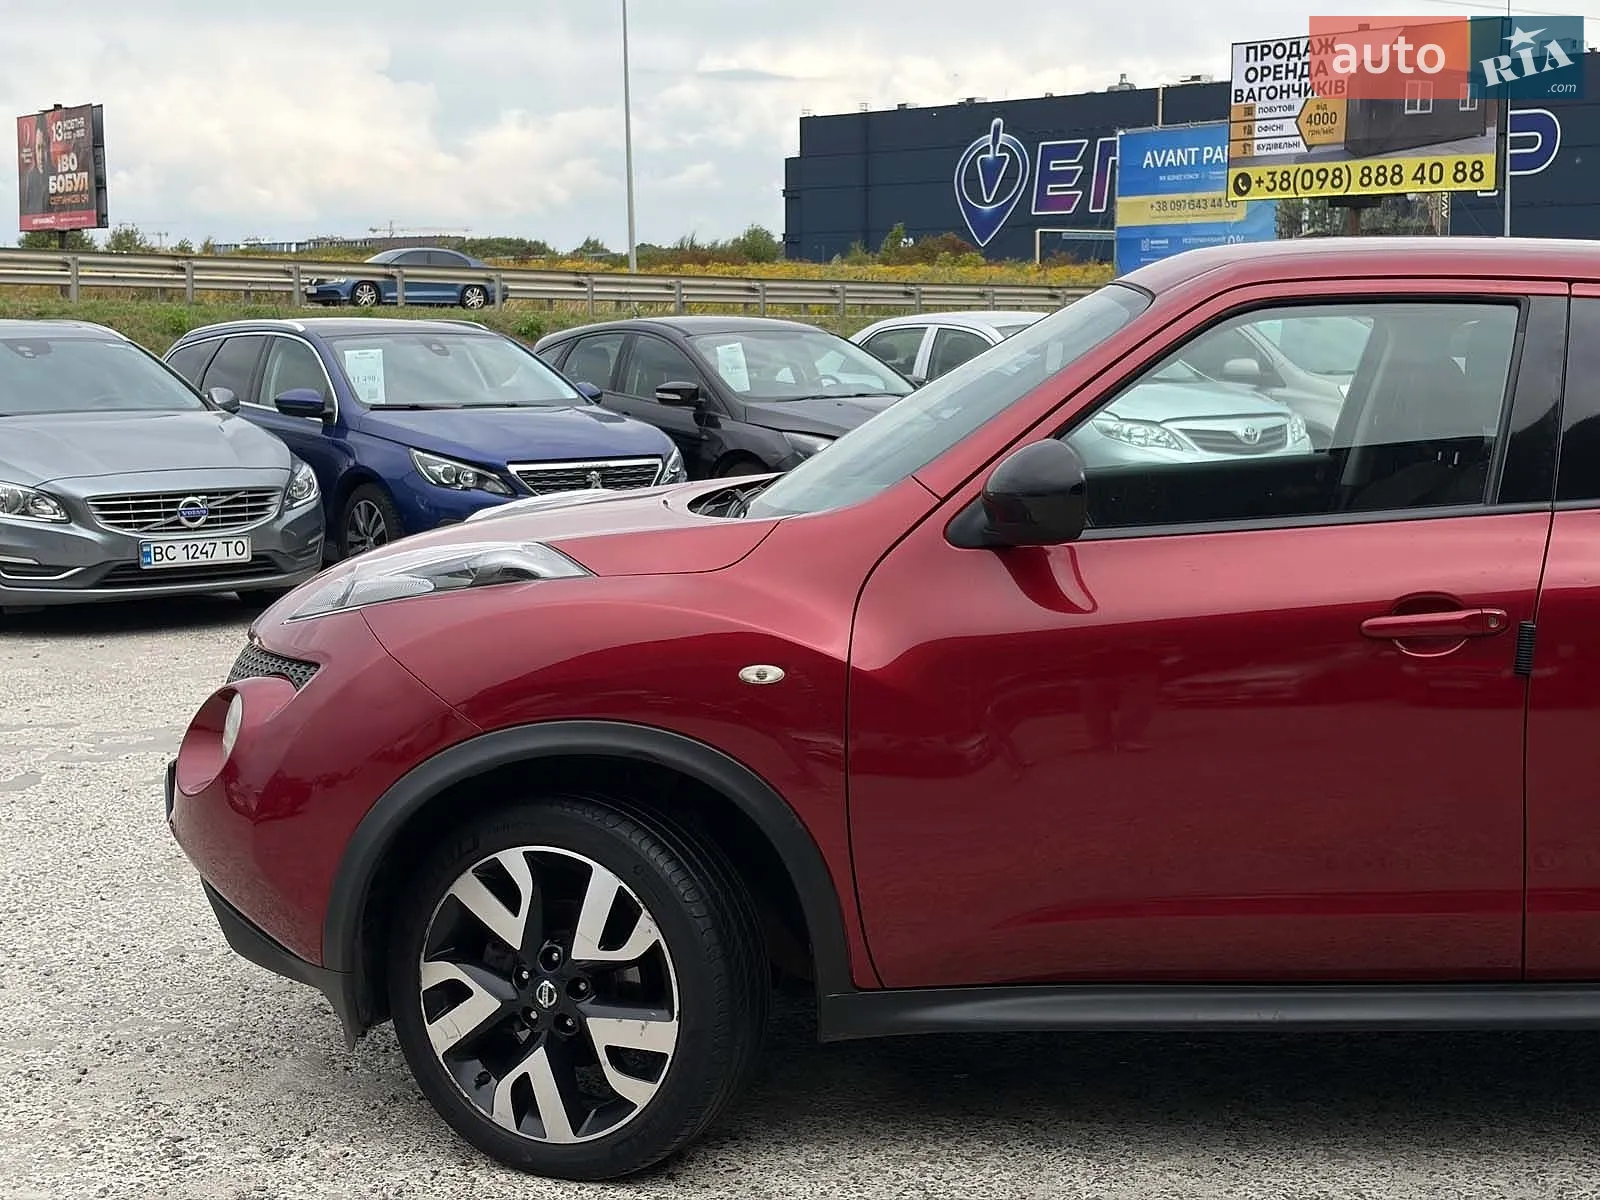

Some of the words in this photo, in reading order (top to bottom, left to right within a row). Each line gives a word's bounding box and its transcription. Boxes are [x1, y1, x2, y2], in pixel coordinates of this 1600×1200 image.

[1246, 37, 1337, 62] ПРОДАЖ
[1245, 59, 1329, 83] ОРЕНДА
[1234, 80, 1346, 104] ВАГОНЧИКІВ
[1258, 104, 1295, 115] ПОБУТОВІ
[1306, 111, 1338, 127] 4000
[51, 121, 63, 142] 13
[1257, 124, 1284, 133] ОФІСНІ
[1256, 142, 1301, 152] БУДІВЕЛЬНІ
[57, 152, 78, 173] ІВО
[1143, 147, 1200, 169] AVANT
[48, 172, 89, 194] БОБУЛ
[1255, 165, 1351, 195] +38(098)
[1359, 163, 1405, 188] 888
[1412, 161, 1445, 185] 40
[1452, 159, 1486, 184] 88
[153, 545, 176, 562] BC
[182, 543, 217, 561] 1247
[222, 541, 246, 557] TO
